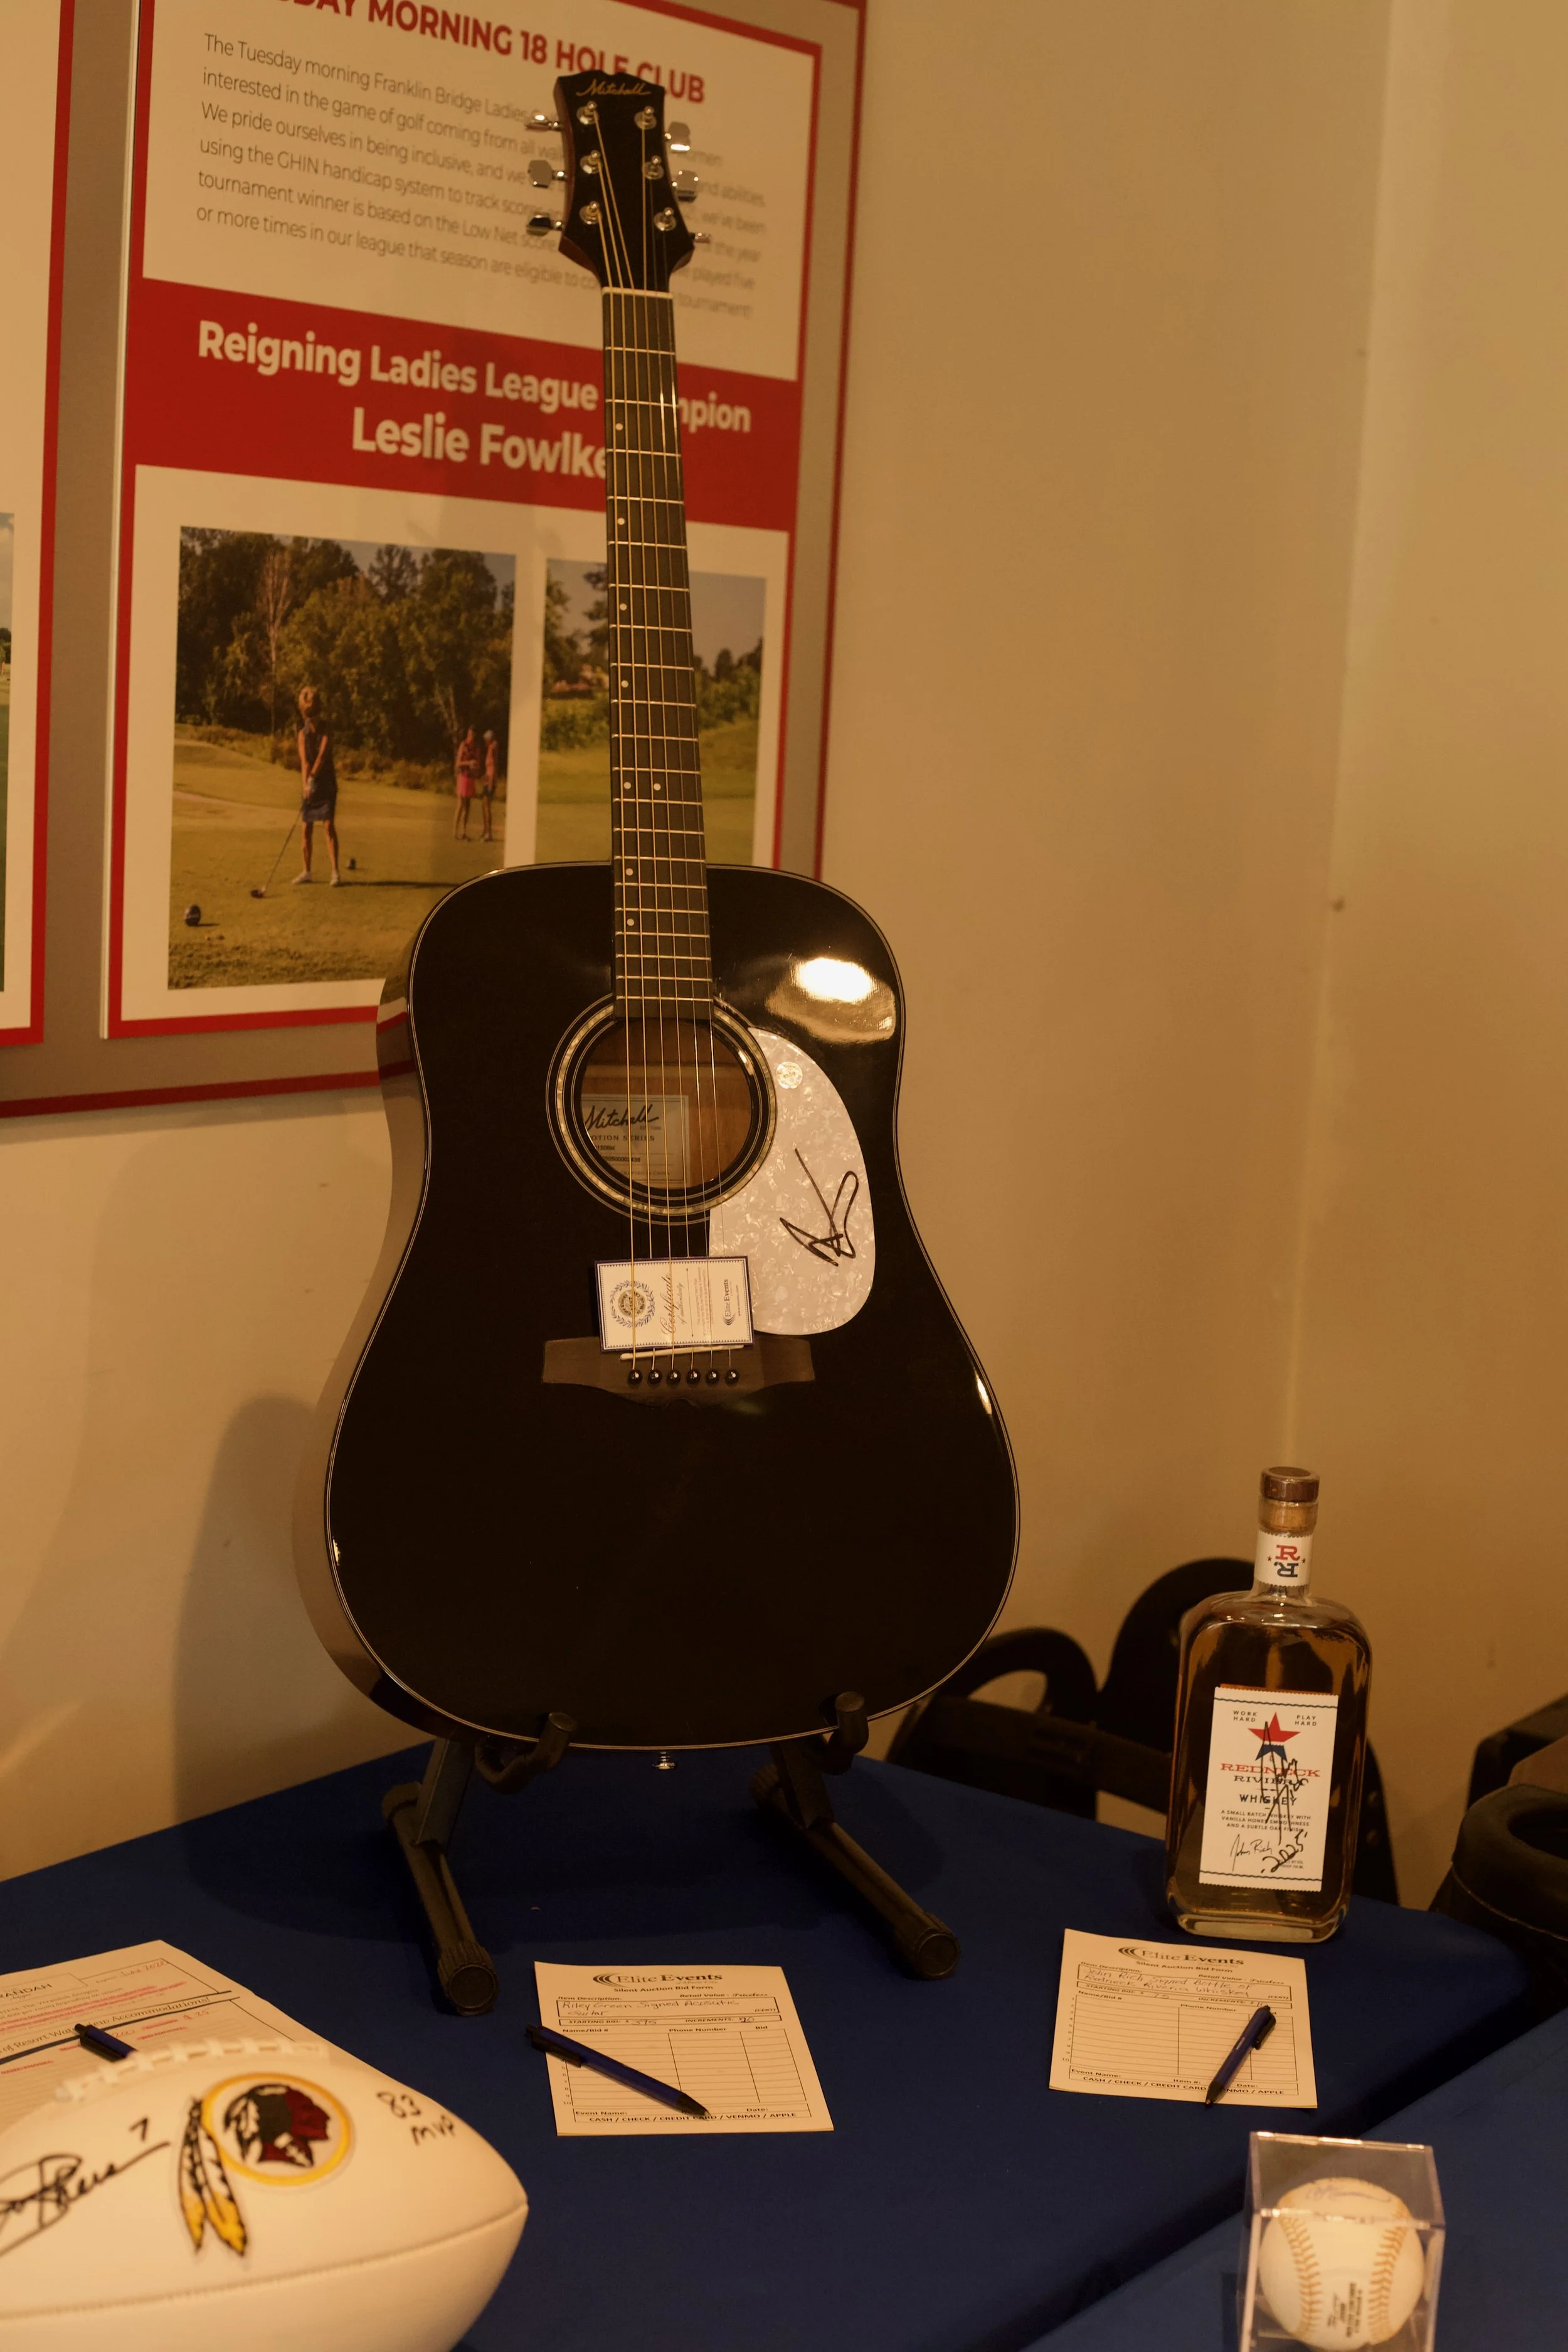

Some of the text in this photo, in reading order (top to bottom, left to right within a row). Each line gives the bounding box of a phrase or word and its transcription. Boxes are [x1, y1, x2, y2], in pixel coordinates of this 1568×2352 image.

[368, 0, 512, 55] MORNING
[520, 30, 547, 64] 18
[204, 33, 233, 56] The
[238, 41, 301, 75] Tuesday
[305, 60, 370, 91] morning
[374, 73, 432, 101] Franklin
[435, 87, 481, 114] Bridge
[484, 98, 528, 122] Ladies
[576, 79, 651, 97] Mitchell
[203, 67, 534, 154] interested in the game of golf coming from all
[202, 101, 526, 184] We pride ourselves in being inclusive, and we
[200, 138, 500, 210] using the GHIN handicap system to track
[198, 171, 293, 203] tournament
[297, 189, 349, 213] winner
[353, 197, 365, 216] is
[367, 200, 410, 224] based
[413, 213, 433, 230] on
[435, 214, 459, 232] the
[462, 221, 490, 240] Low
[494, 226, 517, 245] Net
[196, 206, 213, 221] or
[217, 209, 260, 230] more
[263, 215, 307, 238] times
[310, 223, 324, 241] in
[327, 230, 353, 245] our
[356, 230, 405, 257] league
[408, 240, 437, 262] that
[440, 250, 489, 270] season
[490, 258, 512, 275] are
[514, 261, 563, 284] eligible
[199, 320, 361, 386] Reigning
[371, 345, 477, 394] Ladies
[485, 361, 599, 414] League
[353, 406, 606, 479] Leslie Fowlke
[584, 1104, 659, 1131] Mitchell
[660, 1271, 677, 1335] Certificate
[1275, 1544, 1300, 1562] R
[1239, 1794, 1297, 1806] WHISKEY
[1142, 1949, 1180, 1961] Elite
[1184, 1954, 1244, 1965] Events
[617, 1975, 657, 1983] Elite
[1119, 1973, 1143, 1982] Rich
[1150, 1976, 1189, 1986] Signed
[1193, 1980, 1231, 1989] Bottle
[1196, 1986, 1249, 1998] Whiskey
[562, 2001, 591, 2011] Riley
[637, 2000, 679, 2010] Signed
[1078, 1990, 1116, 2000] Name/Bid
[14, 2035, 50, 2047] Resort
